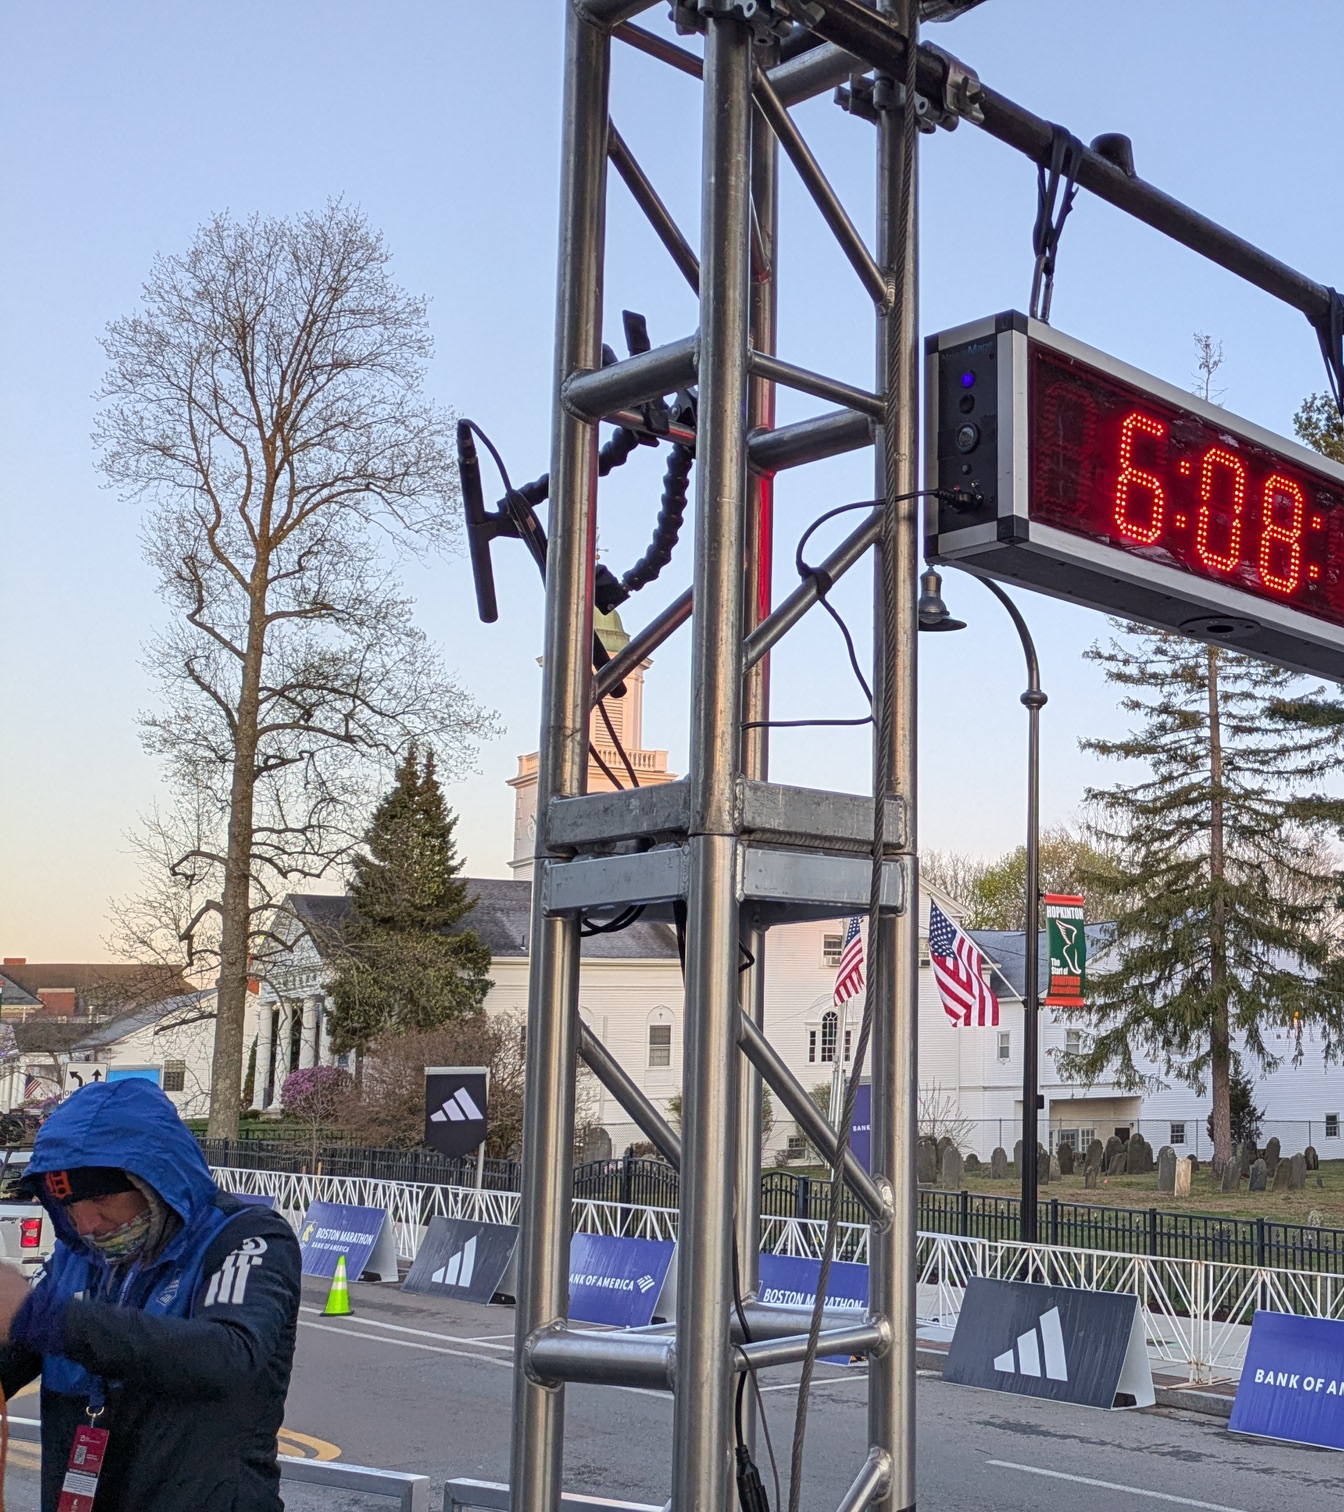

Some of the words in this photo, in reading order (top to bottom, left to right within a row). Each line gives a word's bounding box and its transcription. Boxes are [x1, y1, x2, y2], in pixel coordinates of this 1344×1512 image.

[1046, 905, 1084, 920] HOPKINTON
[1051, 958, 1060, 967] The
[1051, 966, 1063, 975] Start
[852, 1124, 870, 1132] BANK
[315, 1227, 342, 1241] BOSTON
[339, 1230, 374, 1245] MARATHON
[311, 1241, 324, 1249] BANK
[329, 1244, 350, 1253] AMERICA
[568, 1273, 585, 1285] ANK
[585, 1275, 597, 1286] OF
[596, 1276, 634, 1291] AMERICA
[763, 1288, 805, 1305] BOSTON
[1254, 1368, 1300, 1389] BANK
[1302, 1376, 1325, 1392] OF
